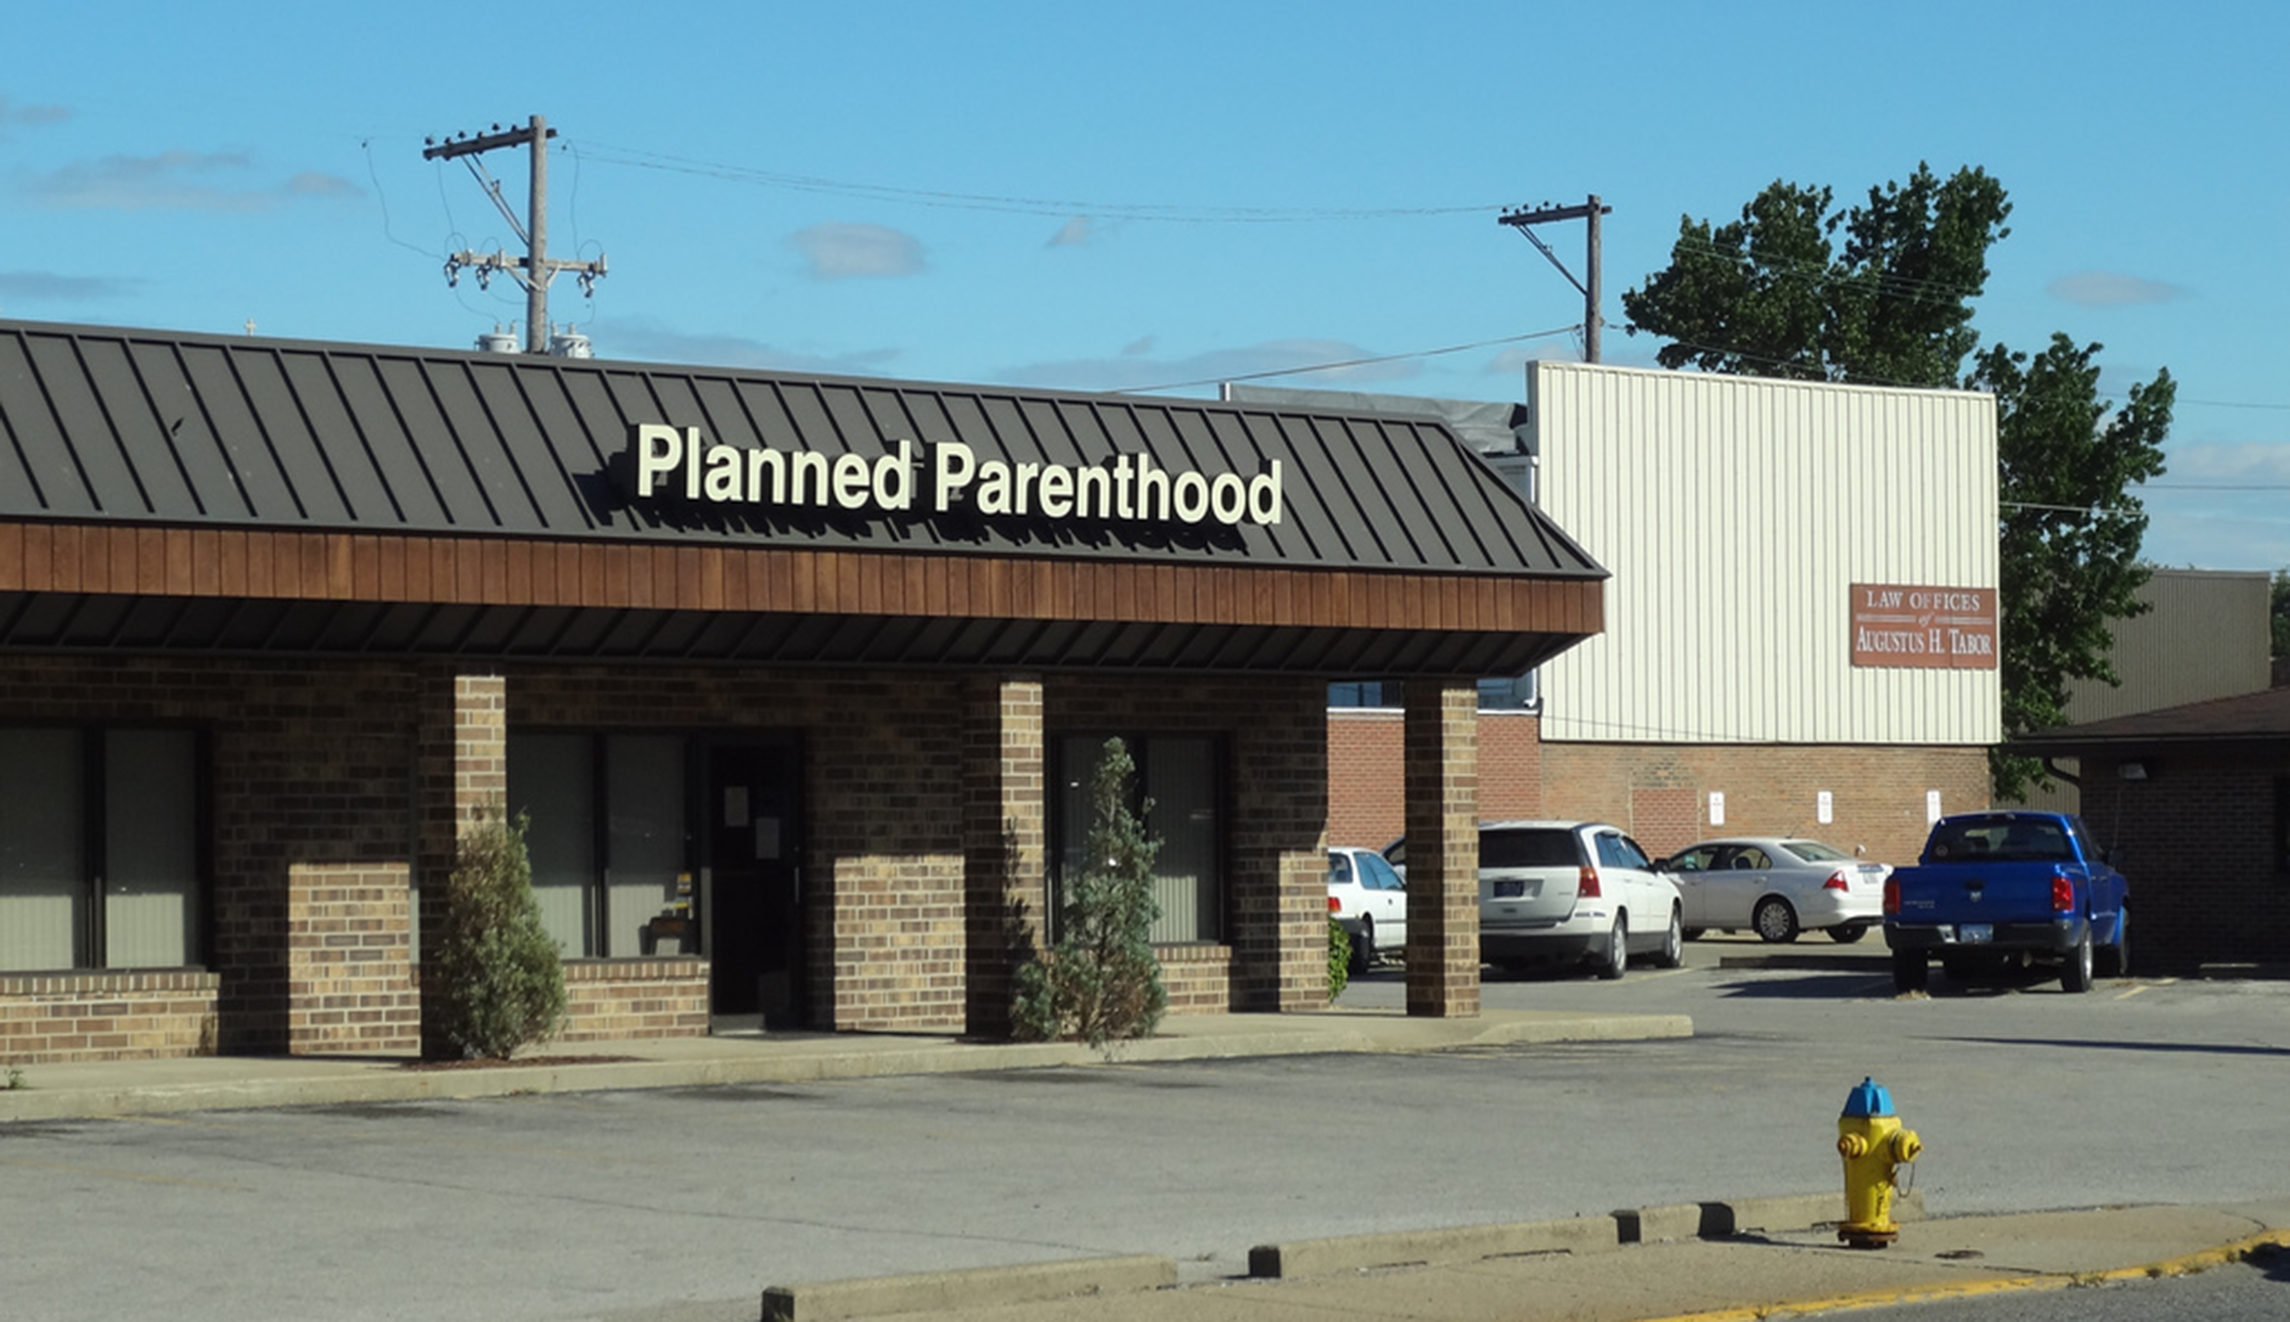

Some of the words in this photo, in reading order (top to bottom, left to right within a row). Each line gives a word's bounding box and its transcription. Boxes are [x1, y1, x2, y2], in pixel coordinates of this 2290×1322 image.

[637, 423, 911, 510] Planned
[935, 441, 1283, 525] Parenthood
[1866, 590, 1903, 608] LAW
[1909, 592, 1981, 611] OFFICES
[1918, 612, 1935, 628] of
[1856, 626, 1925, 653] AUGUSTUS
[1948, 628, 1993, 655] TABOR
